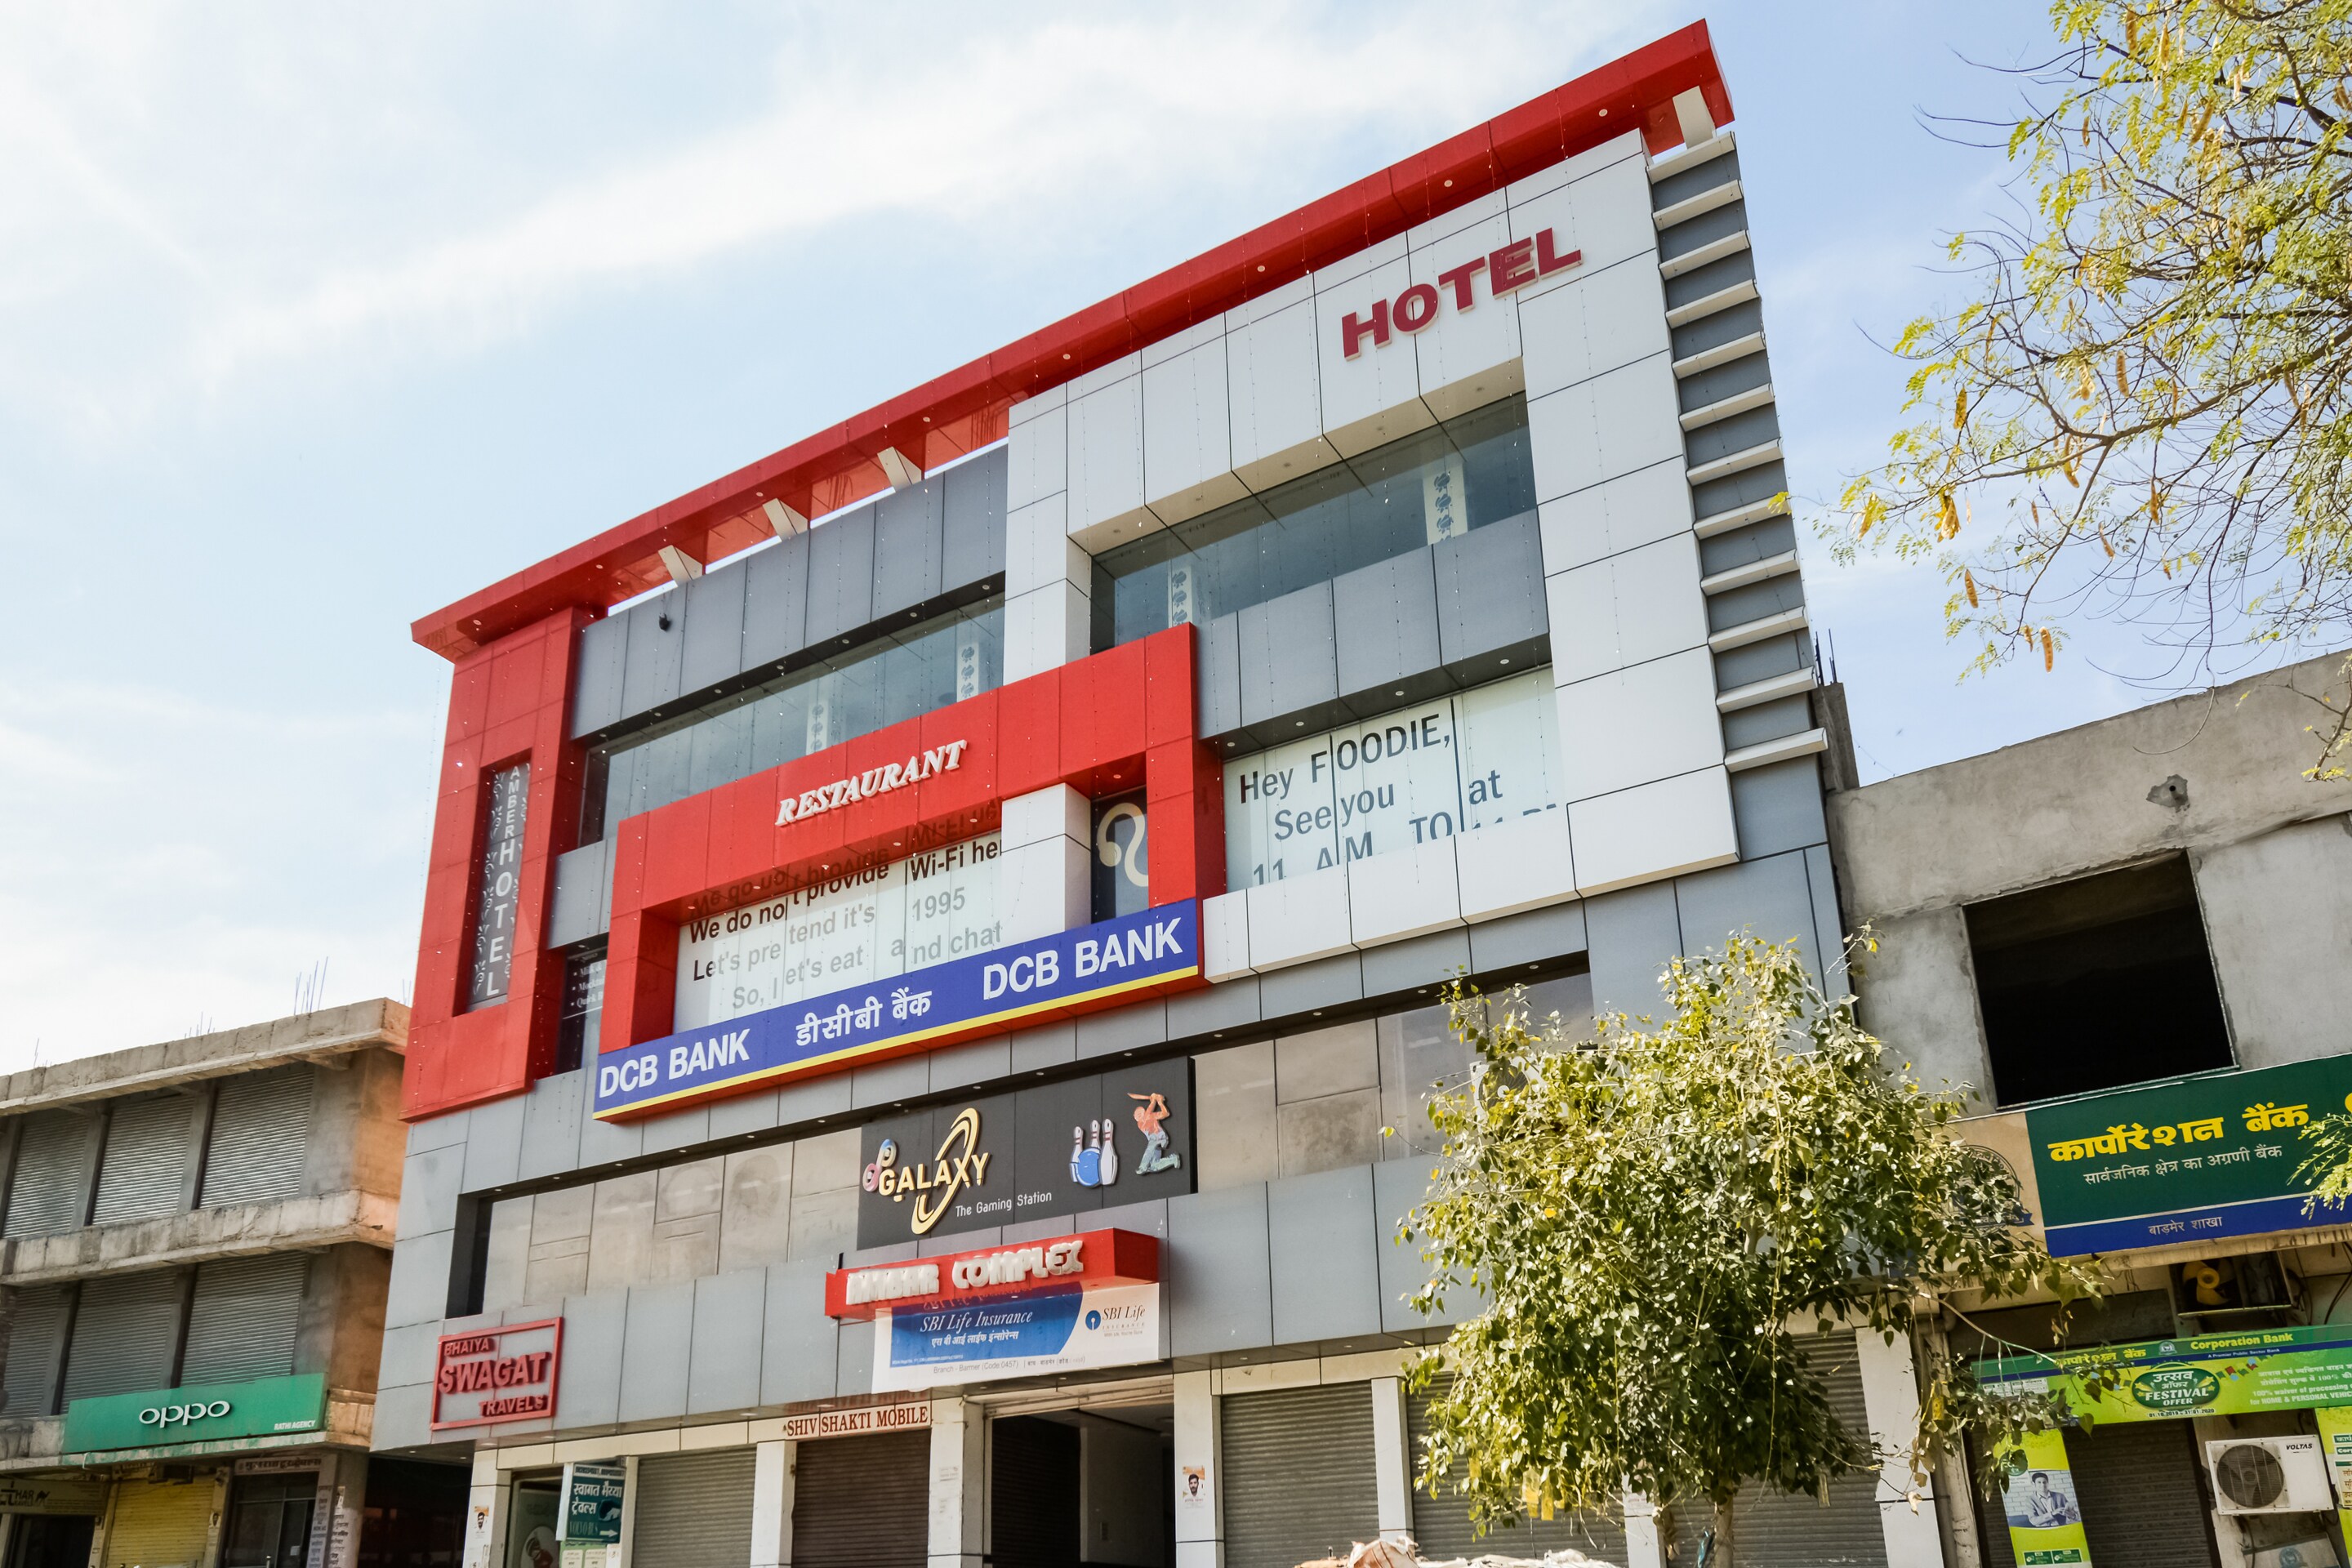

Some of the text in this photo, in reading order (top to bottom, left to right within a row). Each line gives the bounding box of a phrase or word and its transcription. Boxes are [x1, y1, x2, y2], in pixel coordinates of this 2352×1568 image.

[1341, 226, 1584, 362] HOTEL
[774, 738, 969, 827] RESTAURANT
[1240, 768, 1294, 804] Hey
[504, 765, 521, 839] AMBER
[1274, 769, 1503, 840] See you at
[1408, 811, 1453, 844] TO
[689, 918, 720, 944] We
[726, 910, 752, 933] do
[806, 864, 889, 906] provide
[910, 844, 964, 882] Wi-Fi
[486, 839, 515, 996] HOTEL
[693, 951, 740, 981] Let's
[843, 902, 875, 930] it's
[911, 885, 966, 922] 1995
[732, 986, 764, 1009] So,
[830, 944, 864, 973] eat
[950, 920, 1001, 954] chat
[982, 915, 1184, 1001] DCB BANK
[795, 985, 933, 1047] डीसीबी बैंक
[598, 1028, 751, 1099] DCB BANK
[2047, 1116, 2225, 1163] कार्पोरेशन
[2241, 1101, 2310, 1133] बैंक
[877, 1152, 991, 1200] GALAXY
[2082, 1143, 2283, 1187] सार्वजनिक क्षेत्र का अग्रणी बैंक
[955, 1190, 1053, 1218] The Gaming Station
[2189, 1215, 2223, 1232] शाखा
[951, 1240, 1085, 1290] COMPLEX
[920, 1311, 1034, 1334] SBI Life Insurance
[1102, 1304, 1146, 1322] SBI Life
[2123, 1348, 2147, 1359] बैंक
[2190, 1332, 2294, 1351] Corporation Bank
[439, 1351, 552, 1395] SWAGAT
[933, 1365, 954, 1374] Branch
[959, 1363, 981, 1373] Barmer
[2152, 1370, 2194, 1383] उत्सव
[2145, 1388, 2209, 1401] FESTIVAL
[2161, 1381, 2189, 1390] ऑफर
[2163, 1397, 2194, 1406] OFFER
[2274, 1388, 2298, 1396] waiver
[2308, 1383, 2349, 1393] processing
[2292, 1392, 2329, 1402] PERSONAL
[138, 1400, 231, 1428] oppo
[479, 1395, 549, 1418] TRAVELS
[786, 1405, 929, 1437] SHIV SHAKTI MOBILE
[573, 1482, 601, 1497] स्वागत
[571, 1496, 598, 1516] ट्रेवल्स
